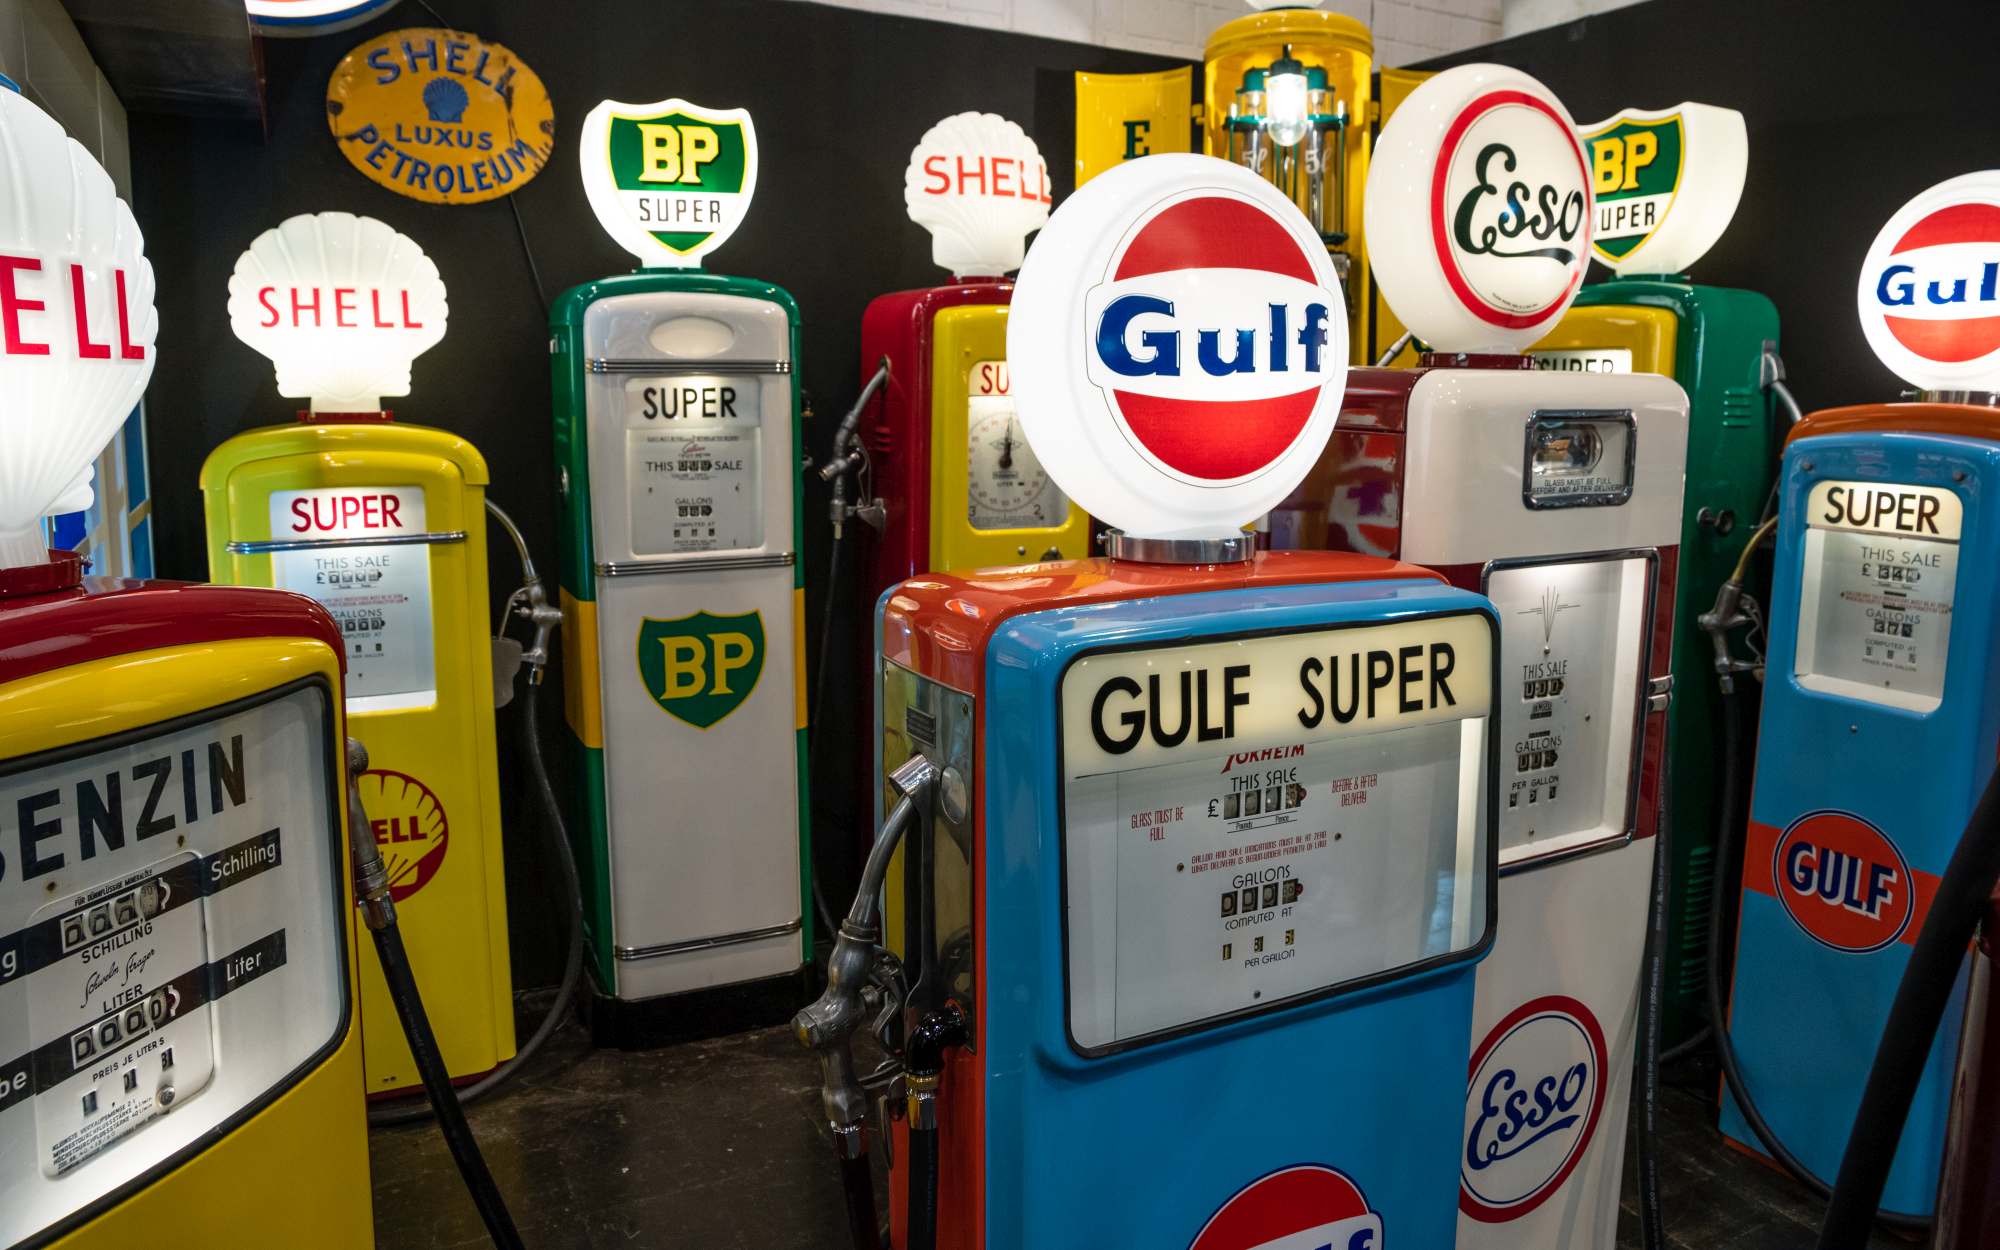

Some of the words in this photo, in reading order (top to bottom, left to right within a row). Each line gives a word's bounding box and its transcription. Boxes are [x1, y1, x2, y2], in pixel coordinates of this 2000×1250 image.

[368, 39, 515, 98] SHELL
[396, 122, 494, 151] LUXUS
[346, 123, 540, 194] PETROLEUM
[637, 123, 720, 185] BP
[1592, 130, 1658, 194] BP
[923, 155, 1053, 205] SHELL
[638, 197, 723, 225] SUPER
[1454, 143, 1585, 266] Esso
[1596, 201, 1656, 231] UPER
[1876, 262, 2000, 306] Gul
[258, 286, 424, 330] SHELL
[1095, 295, 1330, 378] Gulf
[643, 387, 738, 420] SUPER
[646, 461, 674, 472] THIS
[714, 460, 743, 471] SALE
[290, 494, 403, 532] SUPER
[1824, 486, 1940, 534] SUPER
[315, 558, 349, 569] THIS
[355, 555, 391, 567] SALE
[1861, 563, 1871, 577] £
[1862, 546, 1895, 562] THIS
[1900, 551, 1942, 568] SALE
[316, 572, 326, 584] £
[1866, 608, 1921, 625] GALLONS
[658, 631, 755, 699] BP
[1523, 664, 1544, 680] THIS
[1547, 660, 1568, 677] SALE
[1091, 664, 1251, 755] GULF
[1297, 642, 1457, 729] SUPER
[1515, 736, 1563, 754] GALLONS
[1231, 773, 1260, 792] THIS
[1266, 767, 1297, 786] SALE
[1512, 779, 1527, 791] PER
[1531, 775, 1560, 787] GALLON
[0, 734, 246, 884] ENZIN
[1131, 810, 1152, 829] GLASS
[1154, 808, 1174, 825] MUST
[1175, 806, 1184, 821] BE
[1208, 798, 1219, 818] £
[211, 842, 276, 882] Schilling
[1232, 865, 1291, 889] GALLONS
[1787, 841, 1898, 921] GULF
[1224, 911, 1275, 931] COMPUTED
[1281, 907, 1294, 918] AT
[82, 922, 153, 964] SCHILLING
[1244, 957, 1260, 968] PER
[1262, 949, 1295, 965] GALLON
[226, 950, 262, 984] Liter
[103, 983, 144, 1013] LITER
[92, 1062, 119, 1083] PREIS
[122, 1055, 134, 1066] JE
[136, 1041, 158, 1059] LITER
[1467, 1062, 1587, 1170] Esso
